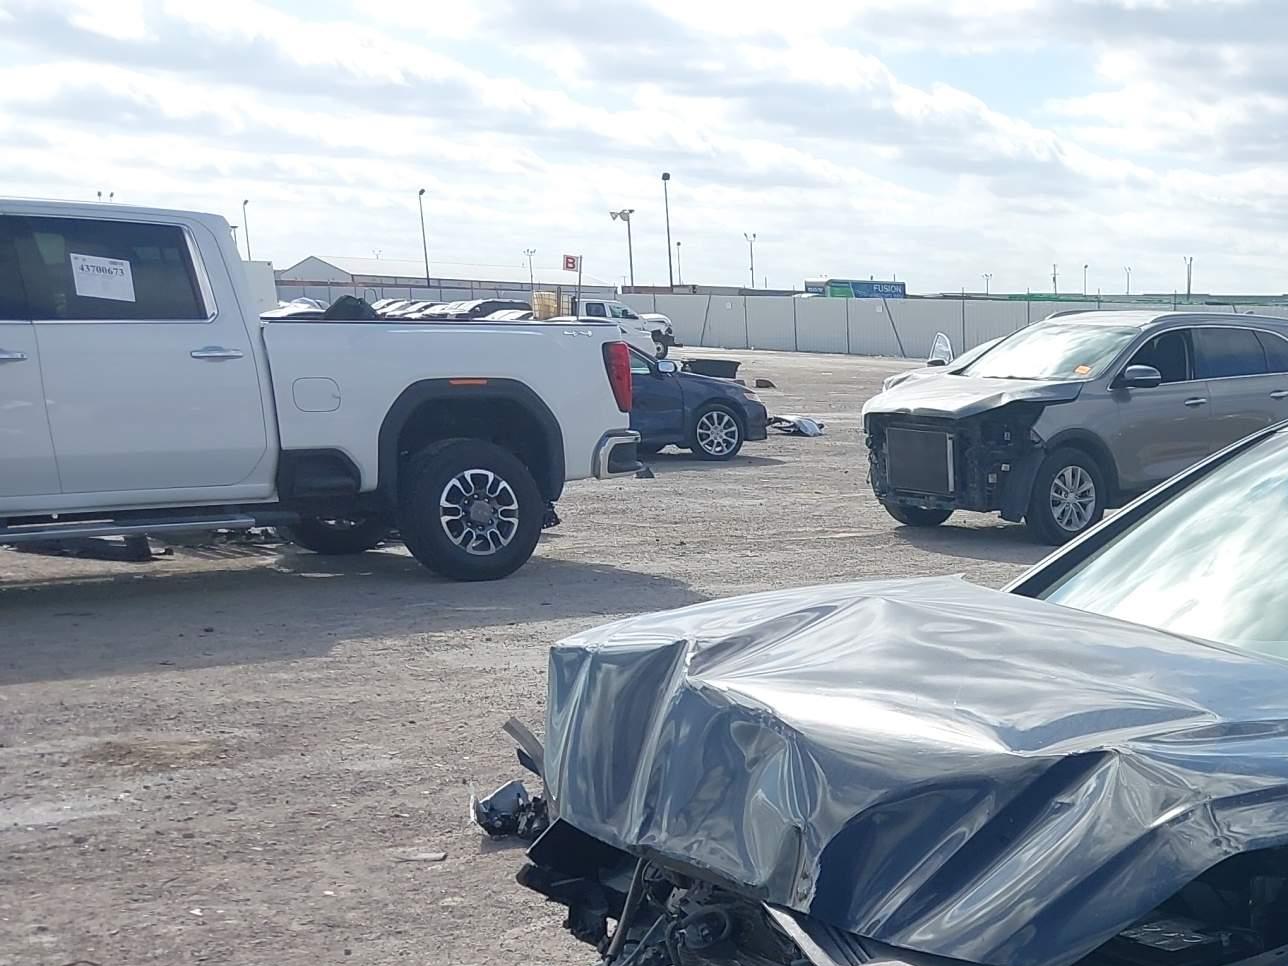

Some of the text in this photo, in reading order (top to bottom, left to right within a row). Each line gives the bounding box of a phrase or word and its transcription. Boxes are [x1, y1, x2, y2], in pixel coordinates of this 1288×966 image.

[565, 256, 576, 269] B
[79, 263, 125, 276] 43700673
[873, 284, 902, 294] FUSION
